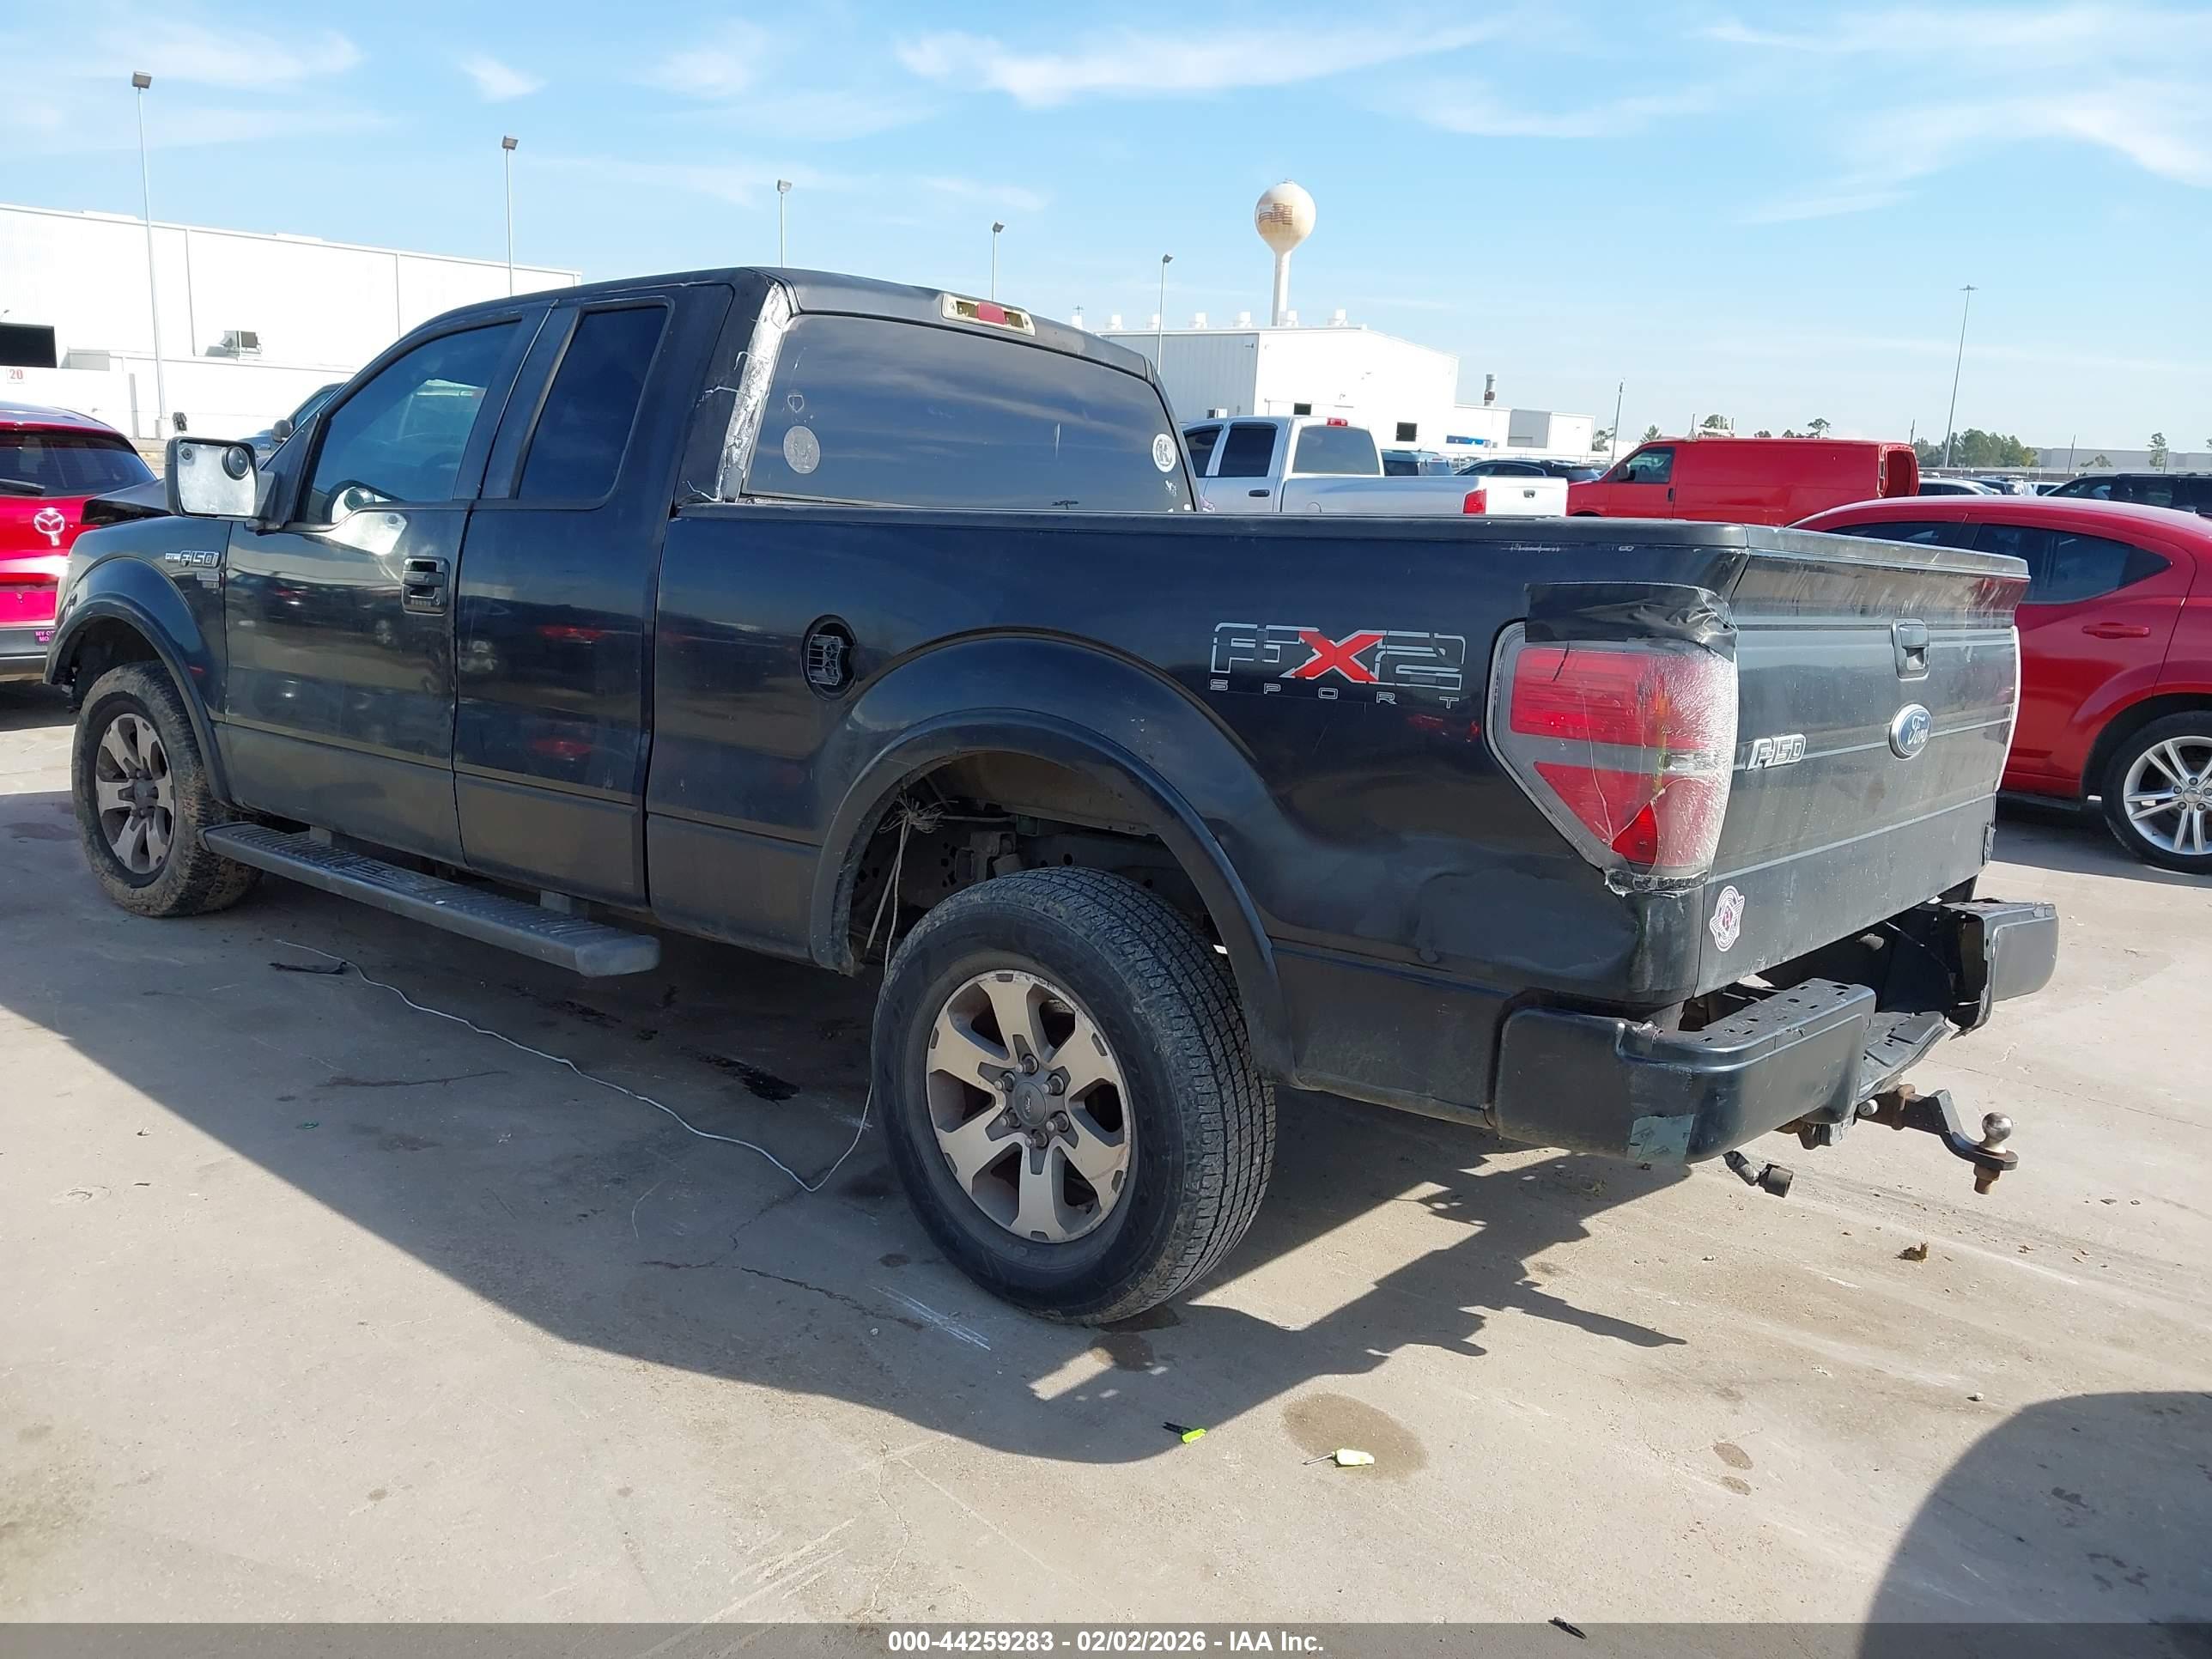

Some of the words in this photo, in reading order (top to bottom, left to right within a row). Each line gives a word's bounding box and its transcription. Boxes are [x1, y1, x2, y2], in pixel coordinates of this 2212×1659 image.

[9, 368, 23, 380] 20
[1210, 622, 1466, 691] FX2
[1209, 678, 1460, 709] SPORT
[1907, 715, 1929, 745] Ford
